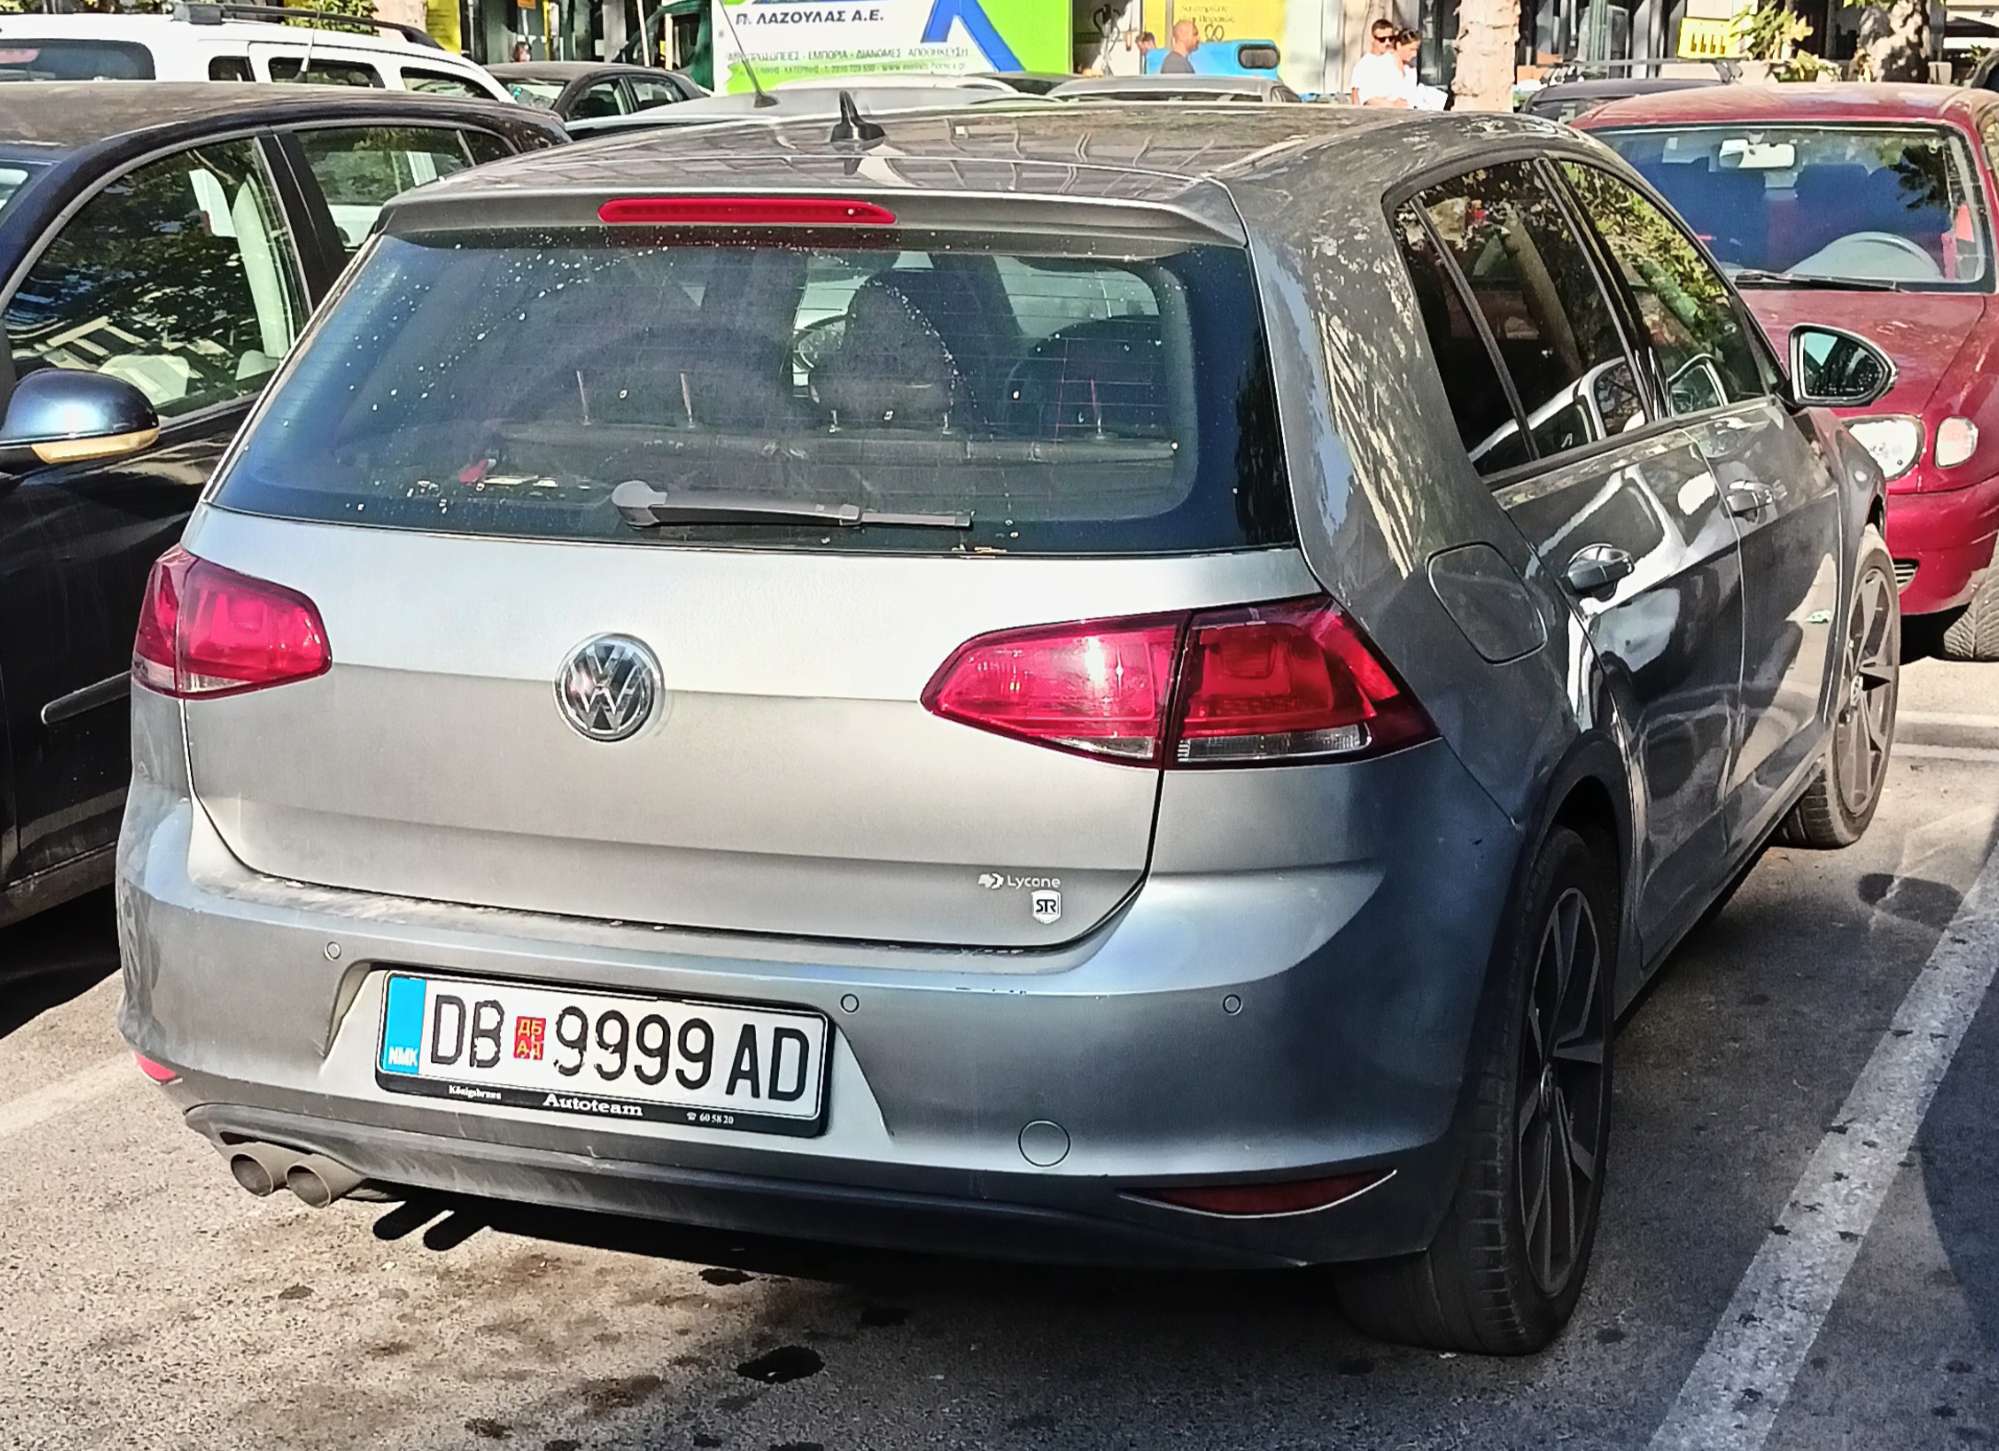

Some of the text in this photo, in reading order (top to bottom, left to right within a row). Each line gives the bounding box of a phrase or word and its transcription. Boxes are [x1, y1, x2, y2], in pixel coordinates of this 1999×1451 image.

[756, 10, 846, 25] ΛΑΖΟΥΛΑΣ
[851, 9, 884, 22] Α.Ε.
[1035, 898, 1057, 913] STR
[388, 1046, 420, 1067] NMK
[430, 993, 810, 1102] DB 9999 AD
[542, 1092, 643, 1117] Autoteam
